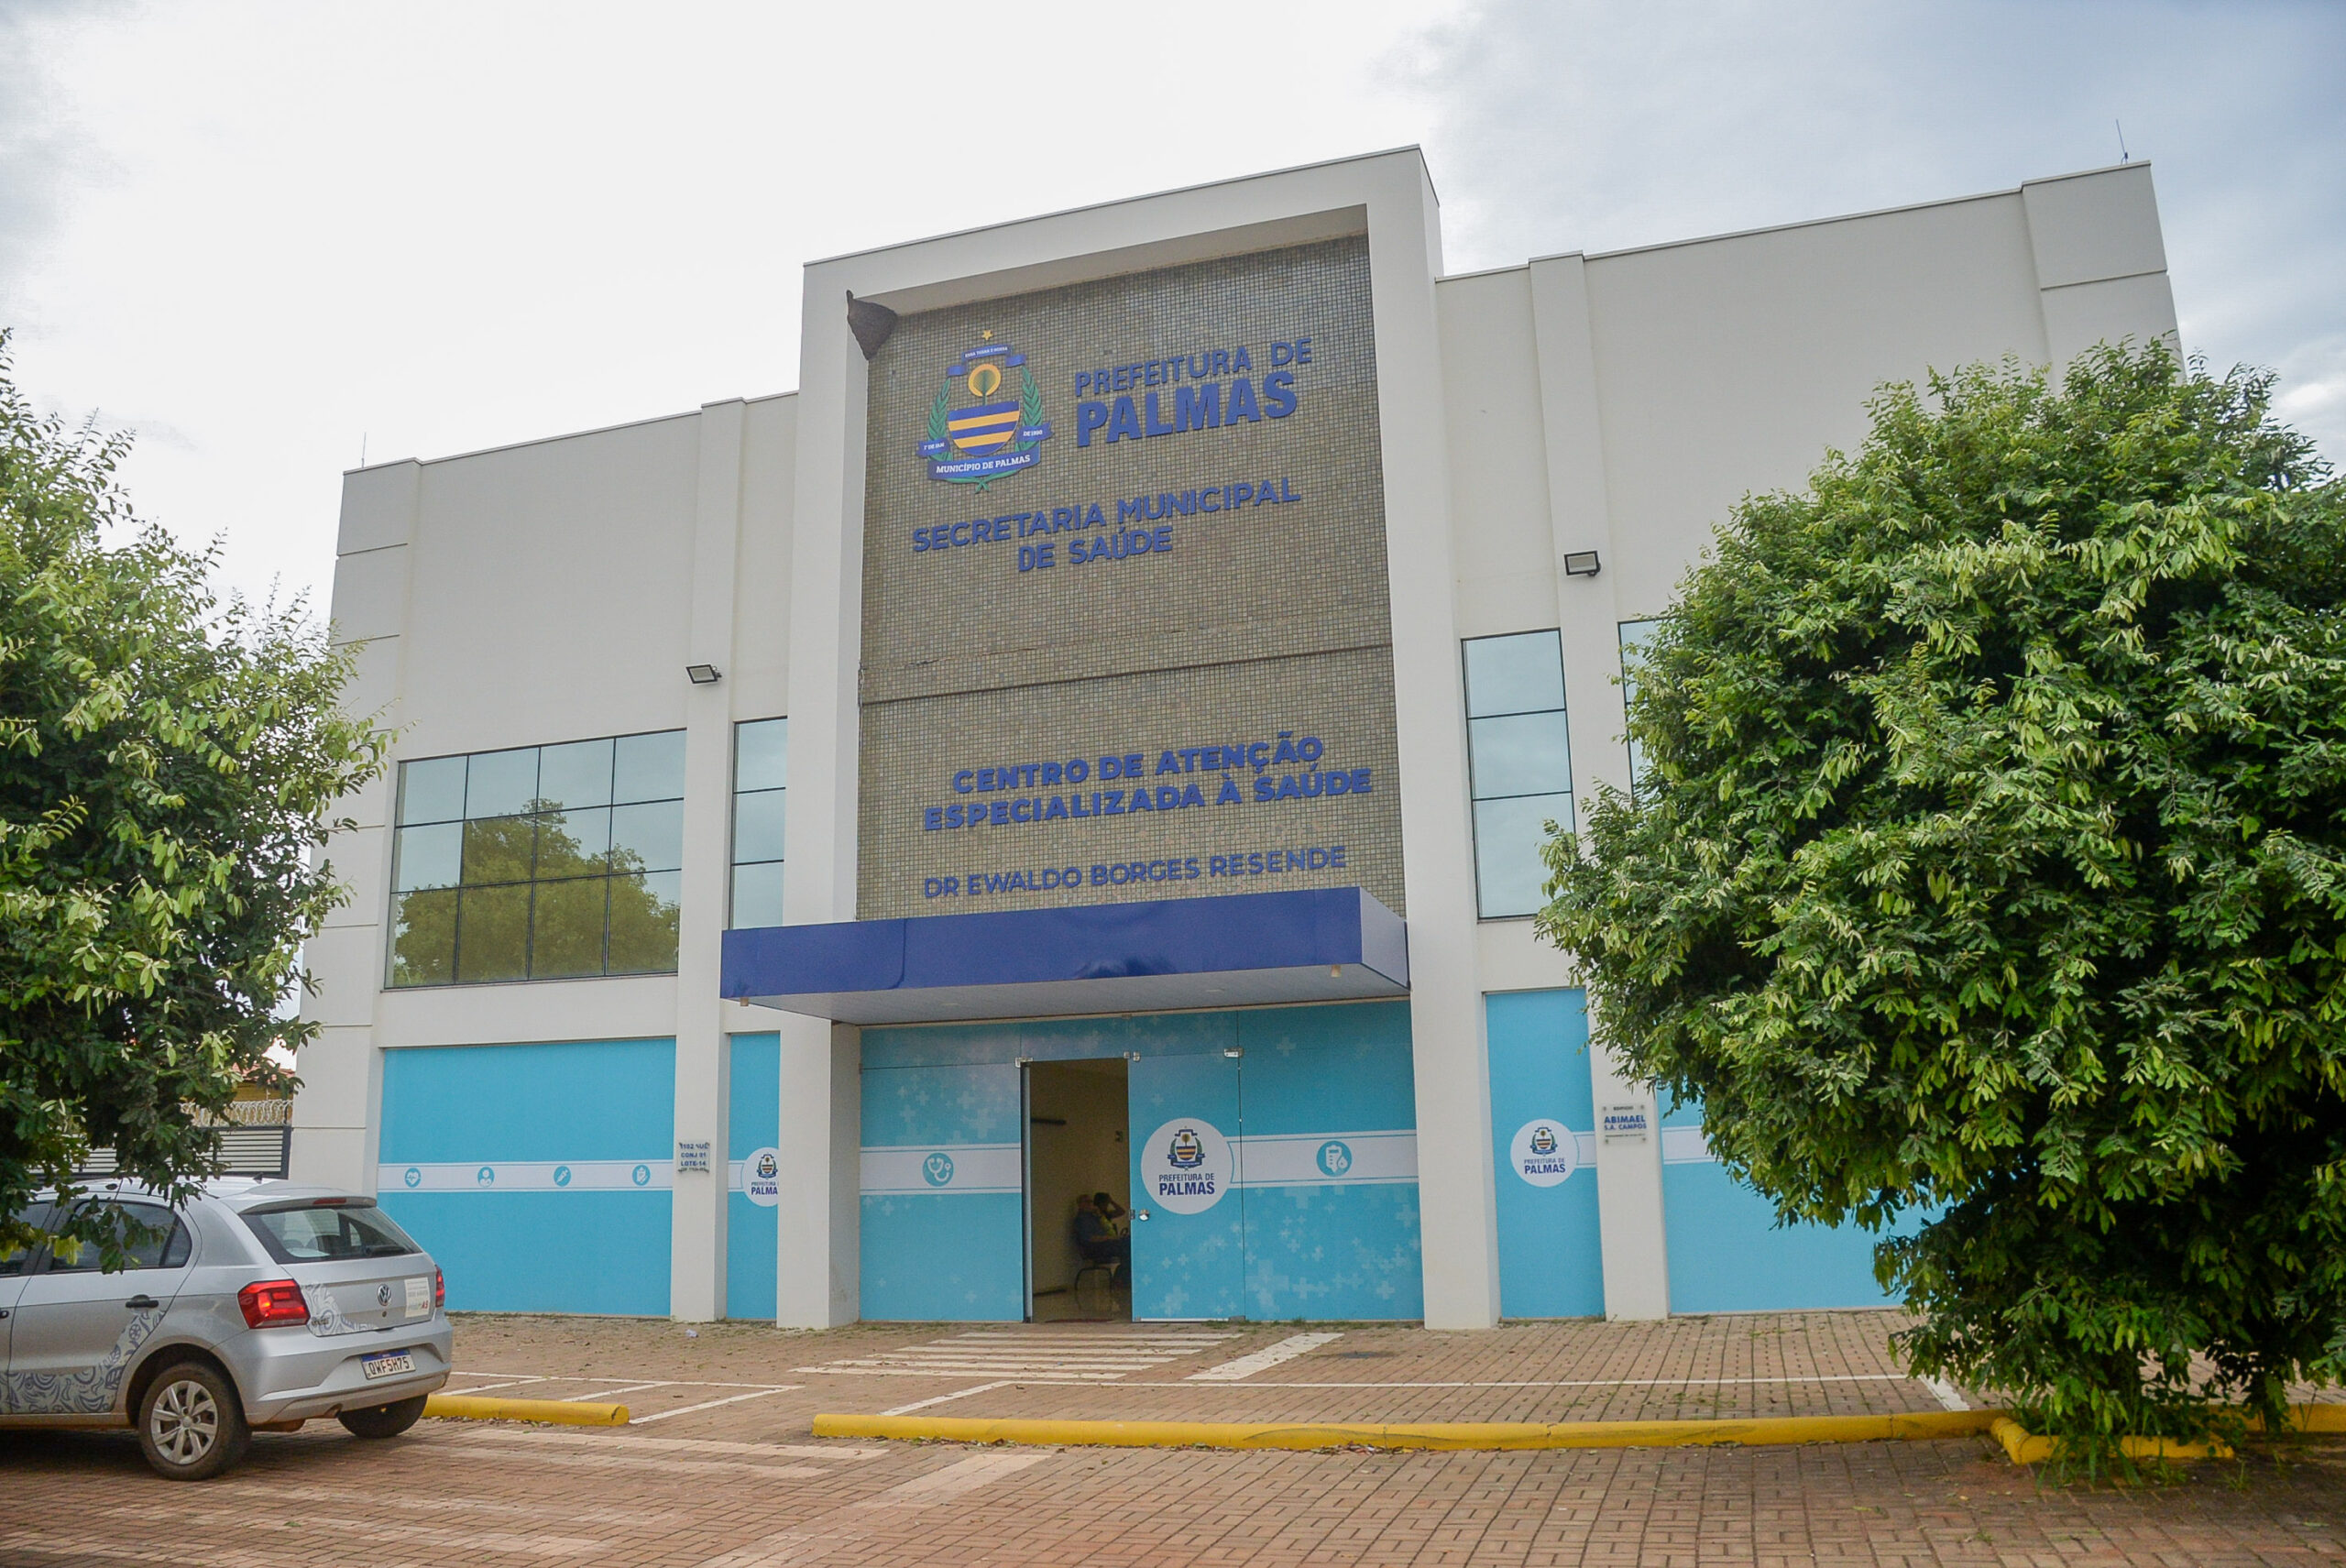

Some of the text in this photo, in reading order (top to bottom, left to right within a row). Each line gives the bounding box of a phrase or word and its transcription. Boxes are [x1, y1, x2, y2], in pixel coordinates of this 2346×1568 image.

[1075, 337, 1312, 397] PREFEITURA DE
[1077, 370, 1298, 447] PALMAS
[936, 455, 1031, 474] MUNICÍPIO DE PALMAS
[913, 477, 1302, 552] SECRETARIA MUNICIPAL
[1018, 524, 1173, 572] DE SAÚDE
[952, 730, 1323, 795] CENTRO DE ATENÇÃO
[924, 762, 1374, 831] ESPECIALIZADA À SAÚDE
[924, 846, 1347, 897] DR EWALDO BORGES RESENDE
[1605, 1114, 1646, 1124] ABIMAEL
[751, 1187, 778, 1195] PALMA
[1158, 1173, 1202, 1181] PREFEITURA
[1159, 1181, 1215, 1196] PALMAS
[1524, 1164, 1566, 1174] PALMAS
